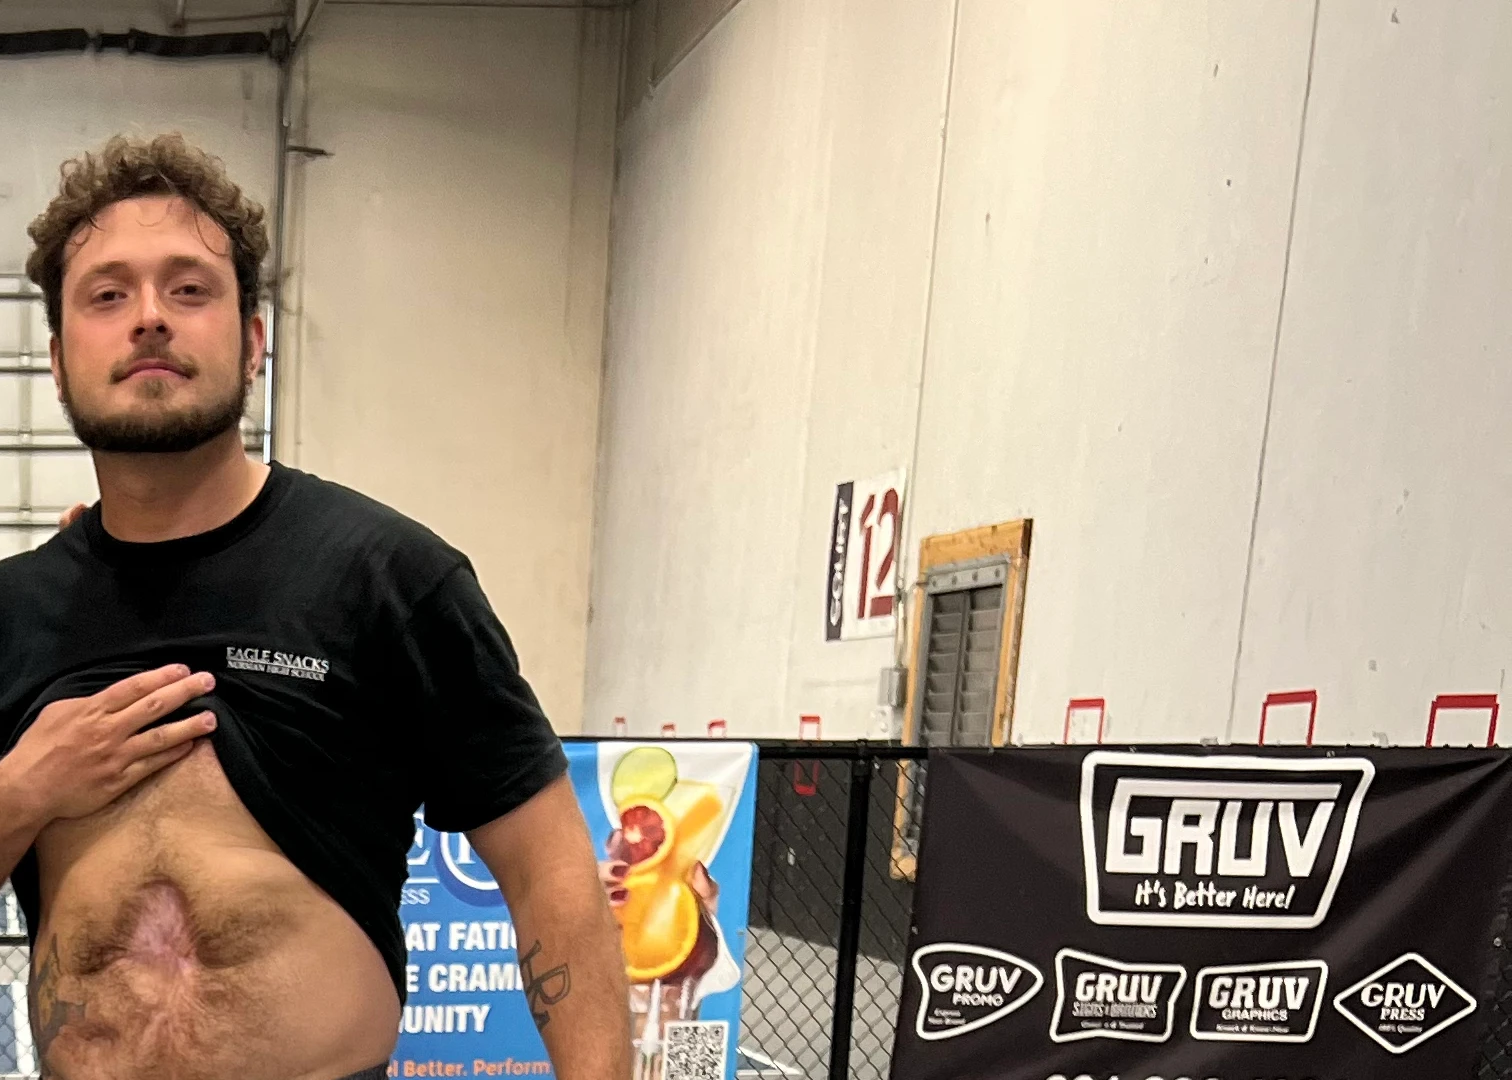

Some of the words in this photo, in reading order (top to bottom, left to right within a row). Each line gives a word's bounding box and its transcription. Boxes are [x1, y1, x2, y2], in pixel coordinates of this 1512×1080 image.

[857, 487, 899, 619] 12
[226, 646, 271, 663] EAGLE
[273, 651, 329, 672] SNACKS
[1104, 777, 1343, 878] GRUV
[1135, 879, 1166, 908] It's
[1173, 880, 1237, 910] Better
[1242, 884, 1296, 910] Here!
[403, 922, 442, 951] AT
[930, 963, 1023, 995] GRUV
[1075, 971, 1163, 1003] GRUV
[1208, 975, 1310, 1010] GRUV
[1360, 982, 1447, 1009] GRUV
[398, 1004, 492, 1034] UNITY
[1221, 1007, 1288, 1022] GRAPHICS
[1380, 1006, 1426, 1021] PRESS
[403, 1059, 468, 1078] Better.
[473, 1057, 552, 1077] Perform
